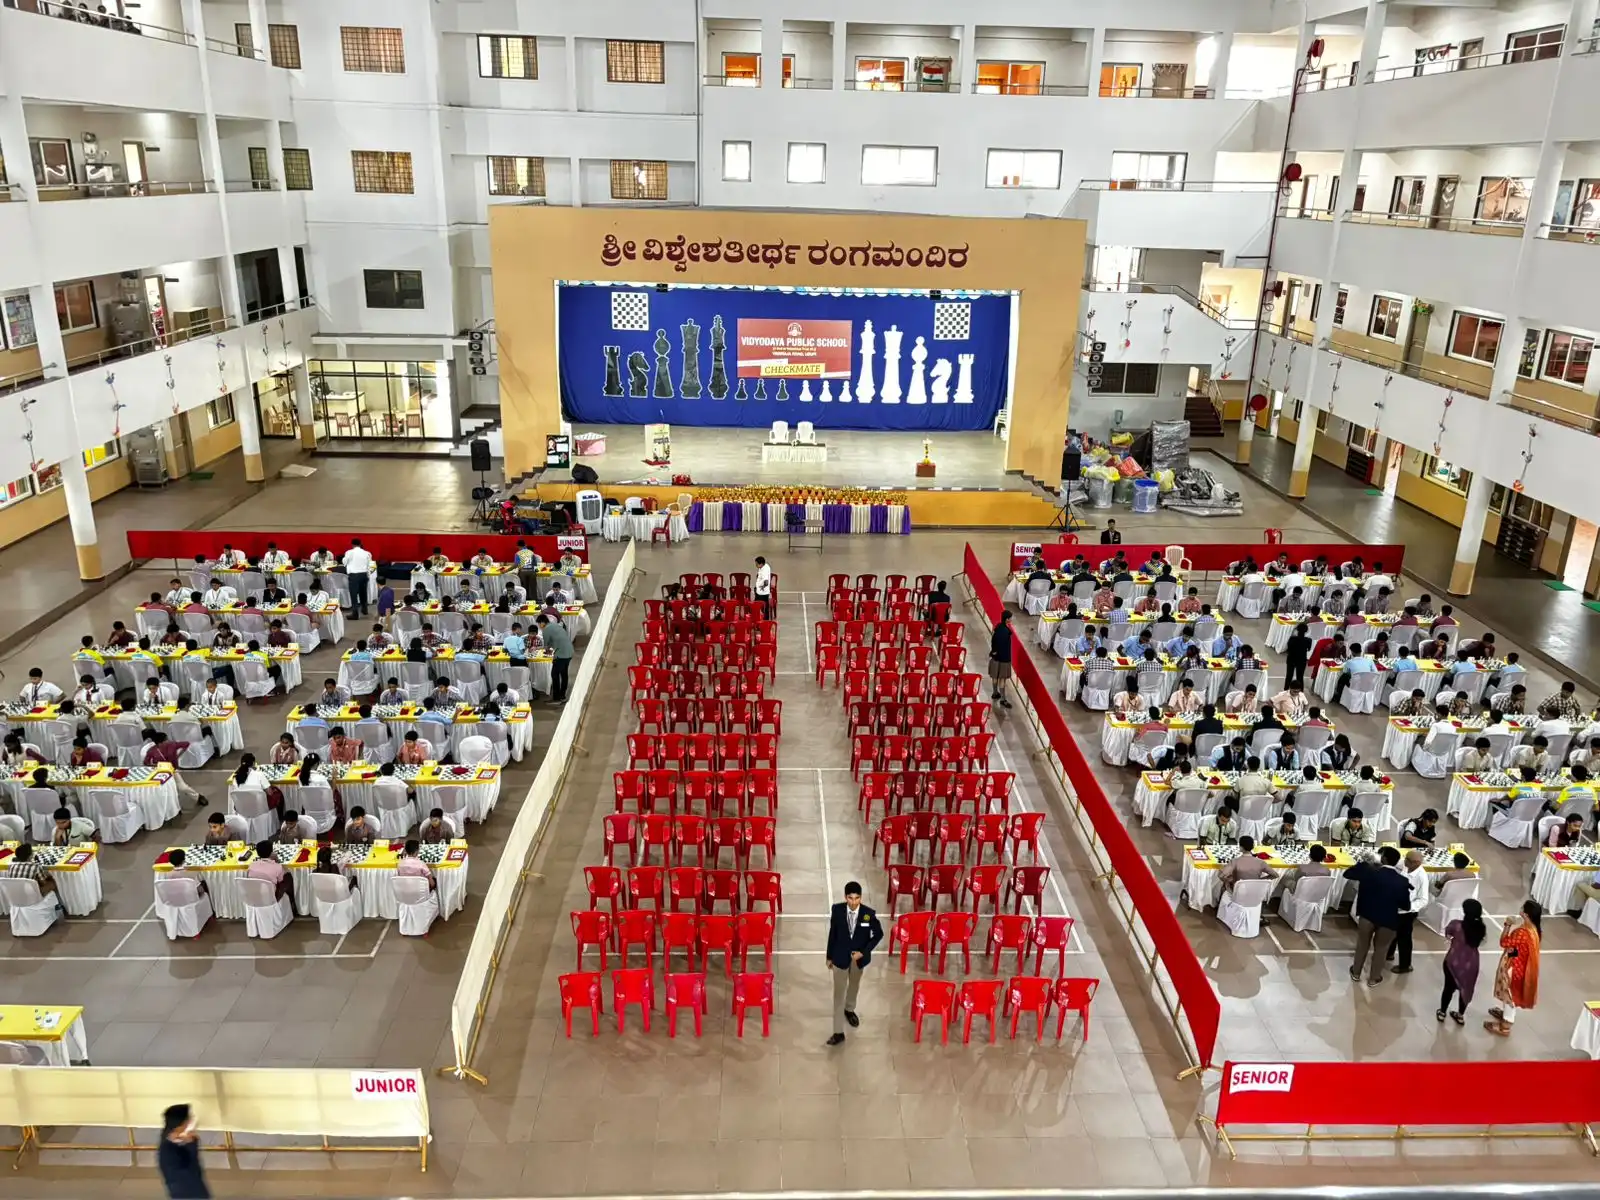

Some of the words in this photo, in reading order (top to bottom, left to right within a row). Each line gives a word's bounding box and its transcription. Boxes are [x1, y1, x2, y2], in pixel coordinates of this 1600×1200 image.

[601, 234, 636, 266] ಶ್ರೀ
[642, 235, 801, 272] ವಿಶ್ವೇಶತೀರ್ಥ
[807, 239, 970, 268] ರಂಗಮಂದಿರ
[741, 336, 785, 347] VIDYODAYA
[786, 337, 815, 347] PUBLIC
[816, 338, 848, 348] SCHOOL
[764, 365, 821, 374] CHECKMATE
[558, 539, 584, 547] JUNIOR
[1232, 1070, 1289, 1086] SENIOR
[355, 1078, 416, 1093] JUNIOR
